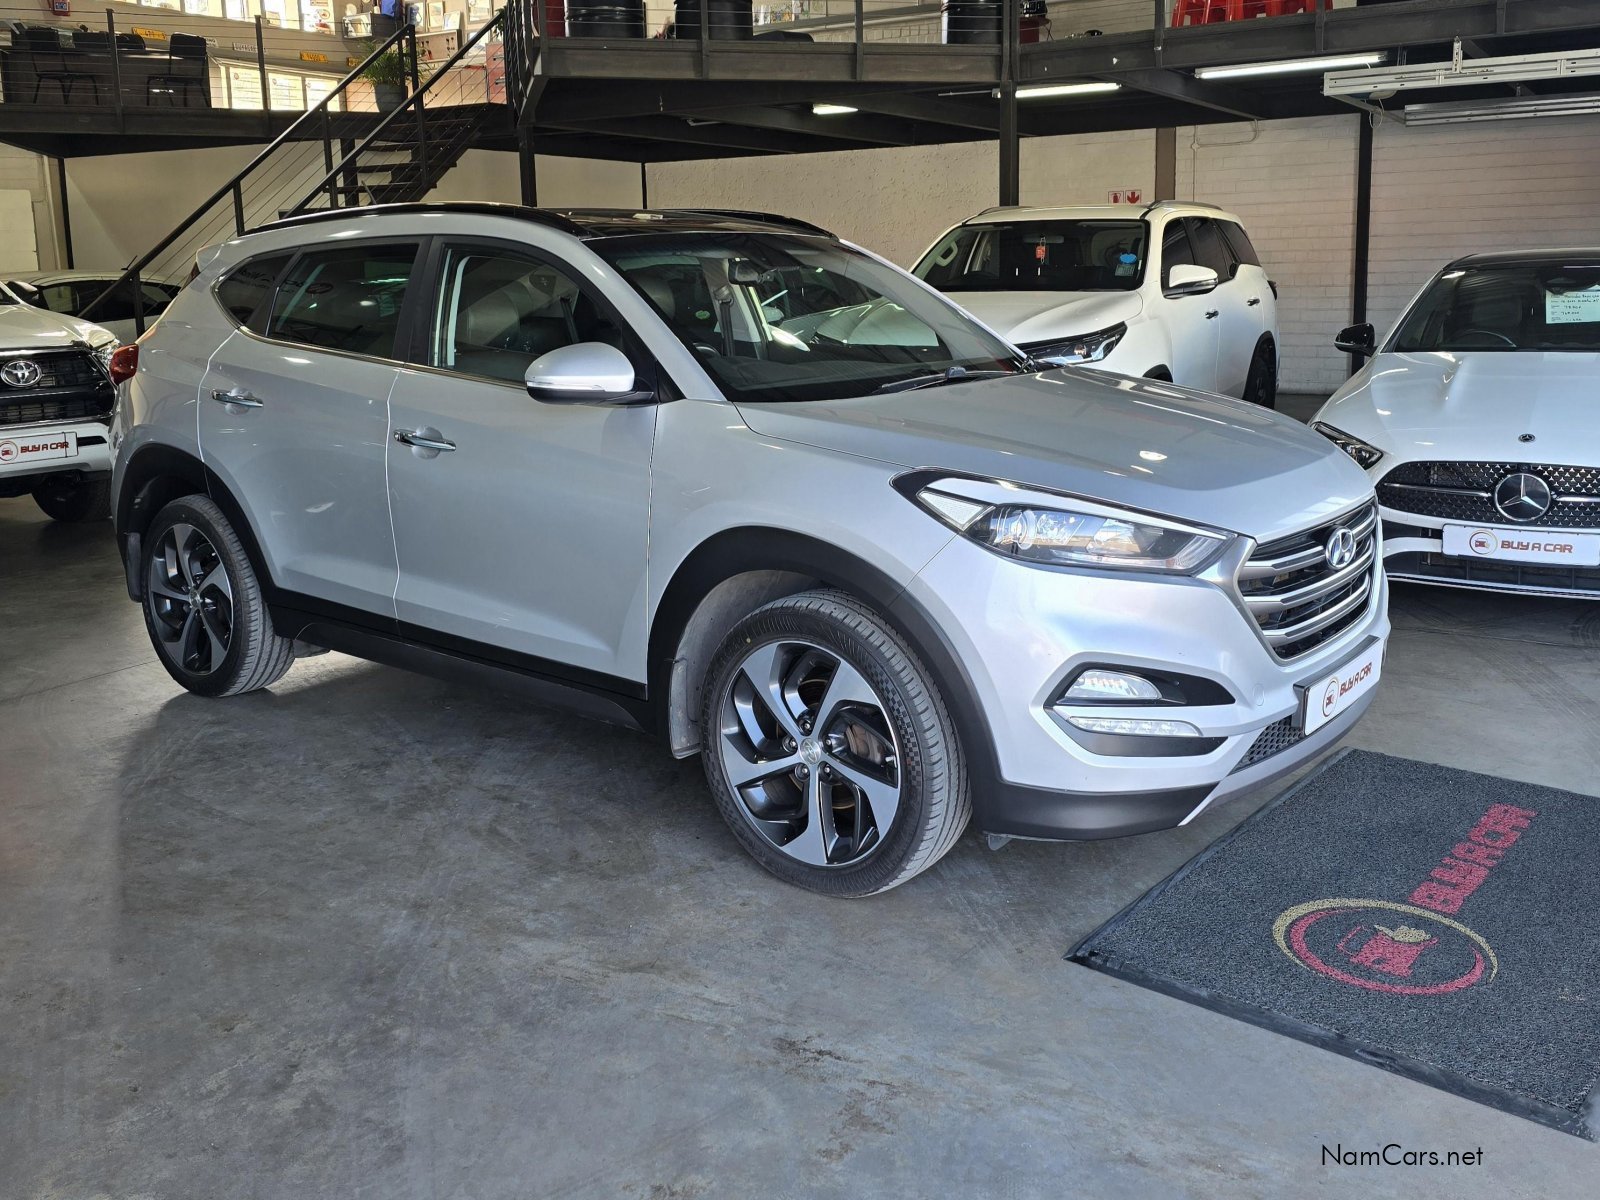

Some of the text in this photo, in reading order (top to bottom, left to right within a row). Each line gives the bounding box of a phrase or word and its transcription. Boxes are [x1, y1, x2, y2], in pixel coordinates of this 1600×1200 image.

[20, 441, 69, 453] BUY A CAR
[1500, 540, 1573, 553] BUY A CAR
[1340, 676, 1356, 697] BUY
[1359, 662, 1372, 682] CAR
